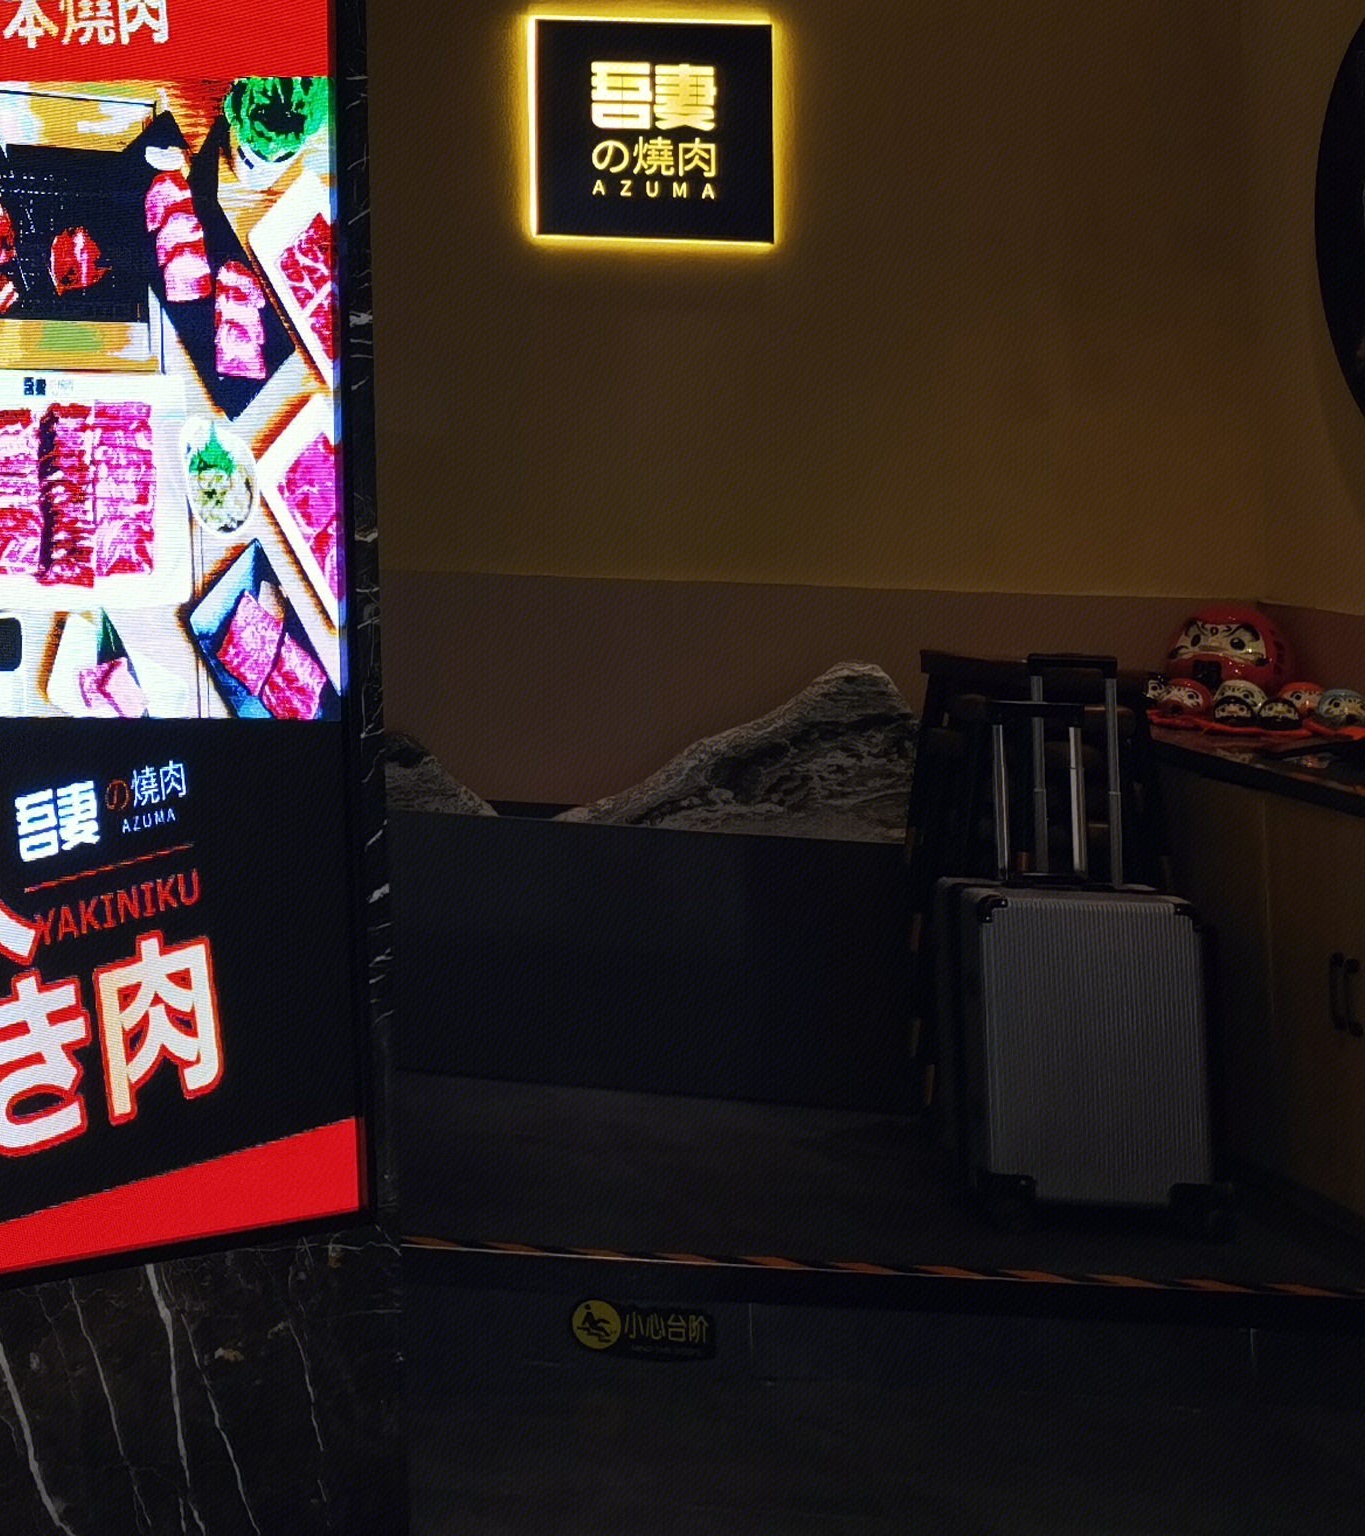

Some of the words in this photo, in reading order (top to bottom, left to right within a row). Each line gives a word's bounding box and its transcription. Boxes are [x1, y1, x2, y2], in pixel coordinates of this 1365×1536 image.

[590, 60, 717, 131] 吾妻
[591, 135, 717, 179] の燒肉
[591, 179, 716, 200] AZUMA
[14, 760, 187, 862] 吾妻の燒肉
[122, 808, 177, 833] AZUMA
[33, 868, 202, 945] YAKINIKU
[623, 1310, 710, 1344] 小心台阶
